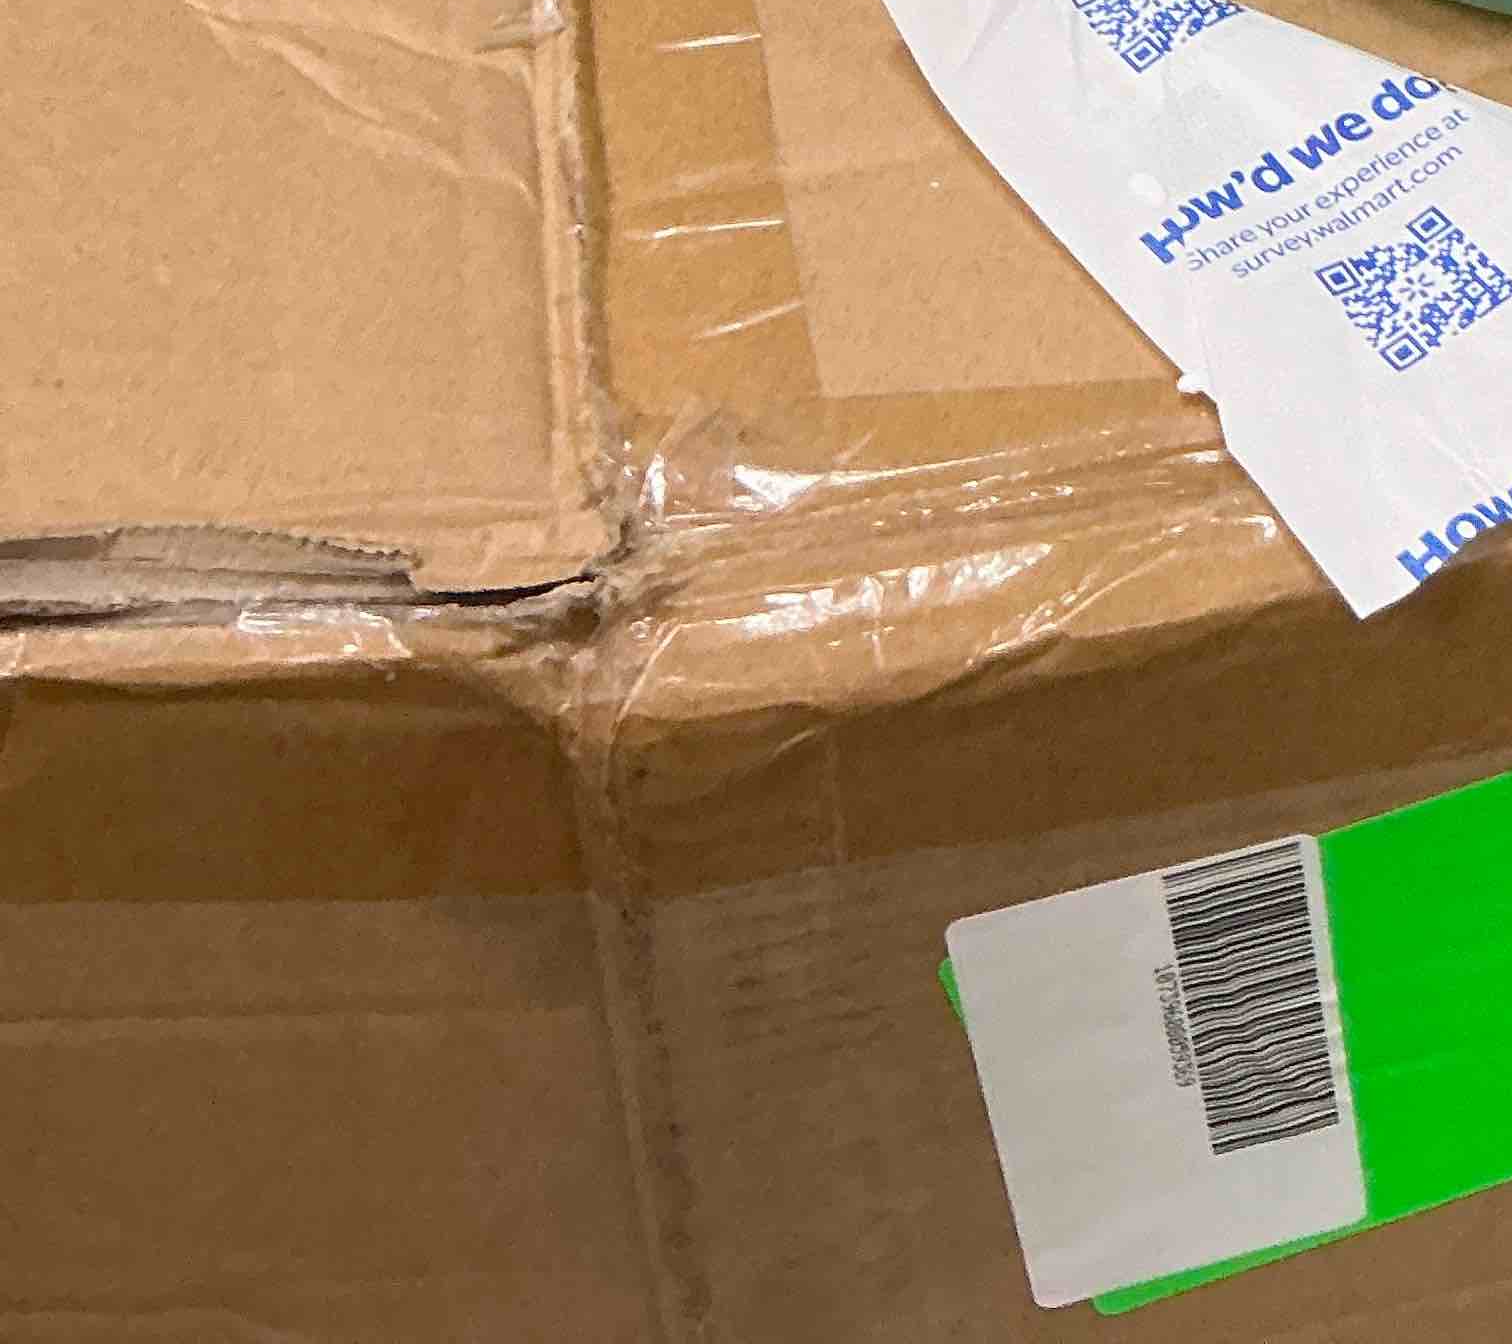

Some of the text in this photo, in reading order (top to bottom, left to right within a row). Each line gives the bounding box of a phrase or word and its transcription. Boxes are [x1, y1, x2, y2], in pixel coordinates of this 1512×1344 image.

[1187, 108, 1471, 272] Share your experience at
[1287, 112, 1374, 171] we
[1370, 74, 1457, 122] do
[1231, 144, 1465, 279] survey.walmart.com
